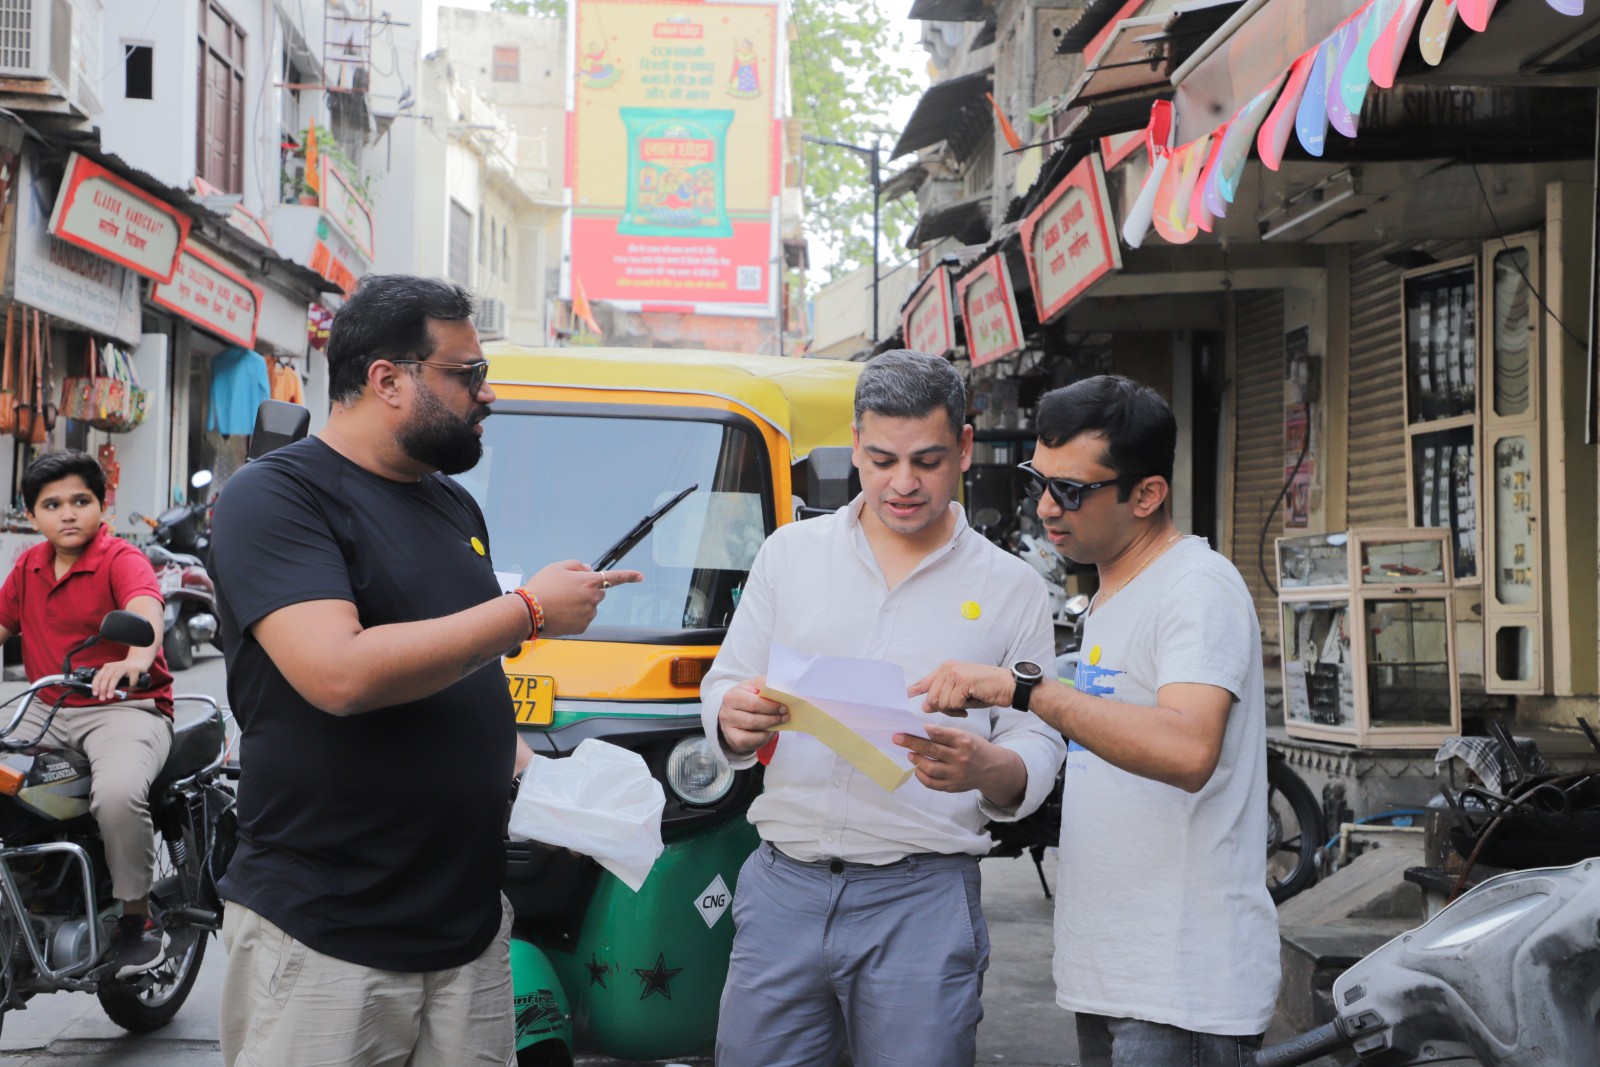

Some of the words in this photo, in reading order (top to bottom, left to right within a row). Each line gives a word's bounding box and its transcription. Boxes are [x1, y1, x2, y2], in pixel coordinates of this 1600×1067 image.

[1402, 89, 1476, 128] SILVER
[506, 677, 537, 699] 7P
[42, 768, 77, 782] HONDA
[702, 893, 726, 909] CNG
